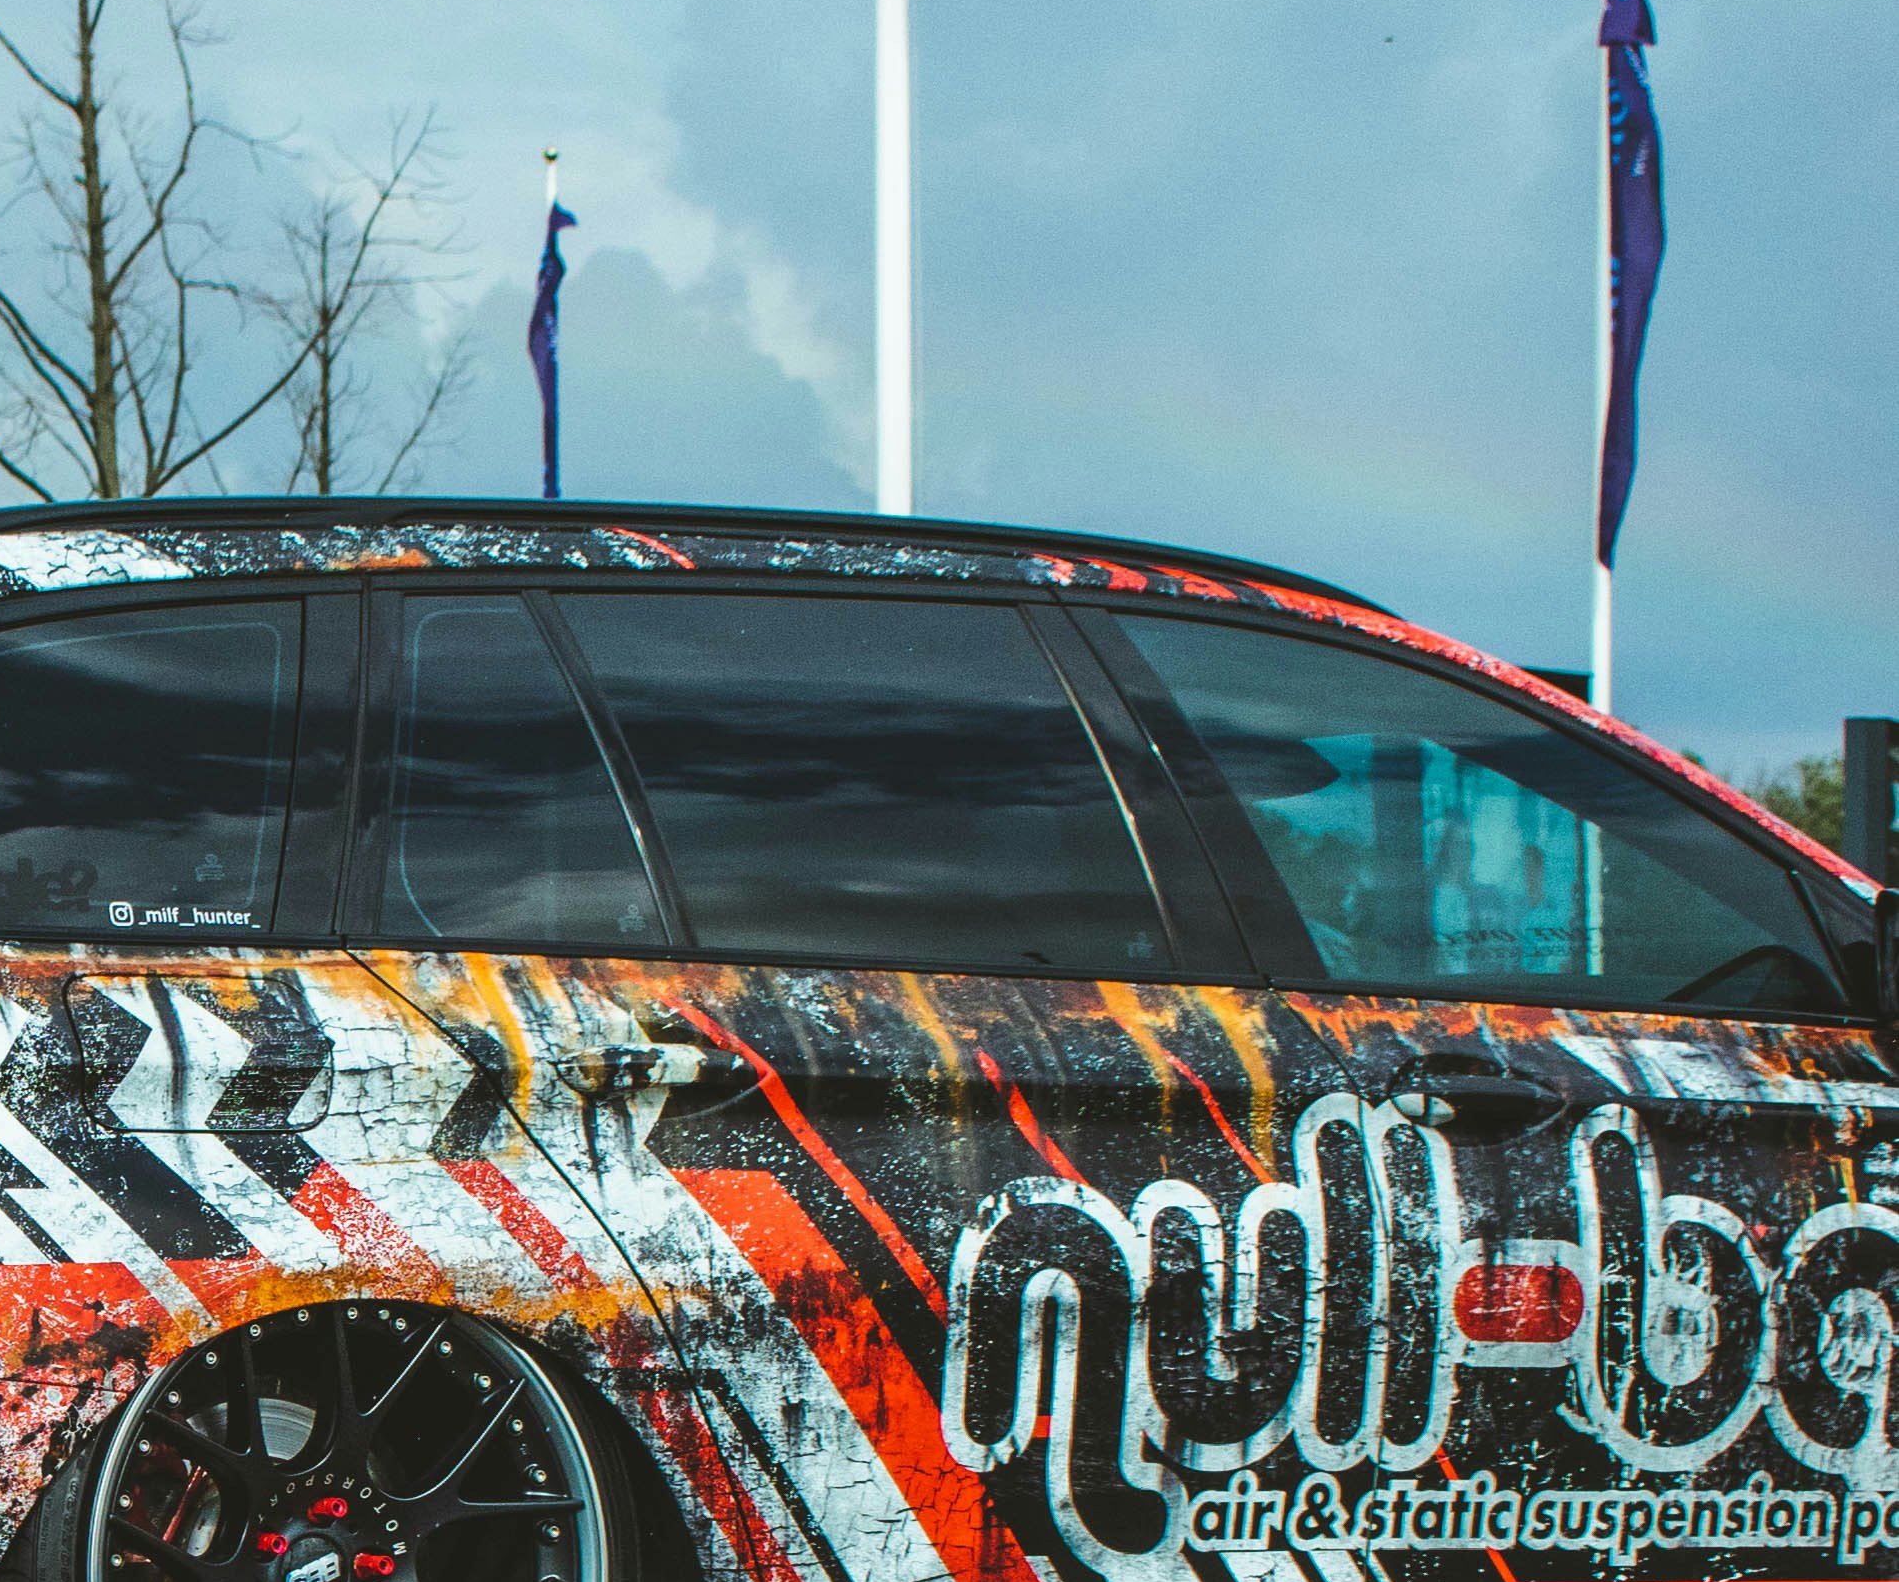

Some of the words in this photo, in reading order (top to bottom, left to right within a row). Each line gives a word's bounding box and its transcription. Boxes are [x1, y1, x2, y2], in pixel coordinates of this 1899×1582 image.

[1189, 1474, 1283, 1545] air
[1292, 1477, 1343, 1544] &
[1358, 1474, 1518, 1545] static
[1528, 1474, 1836, 1560] suspension
